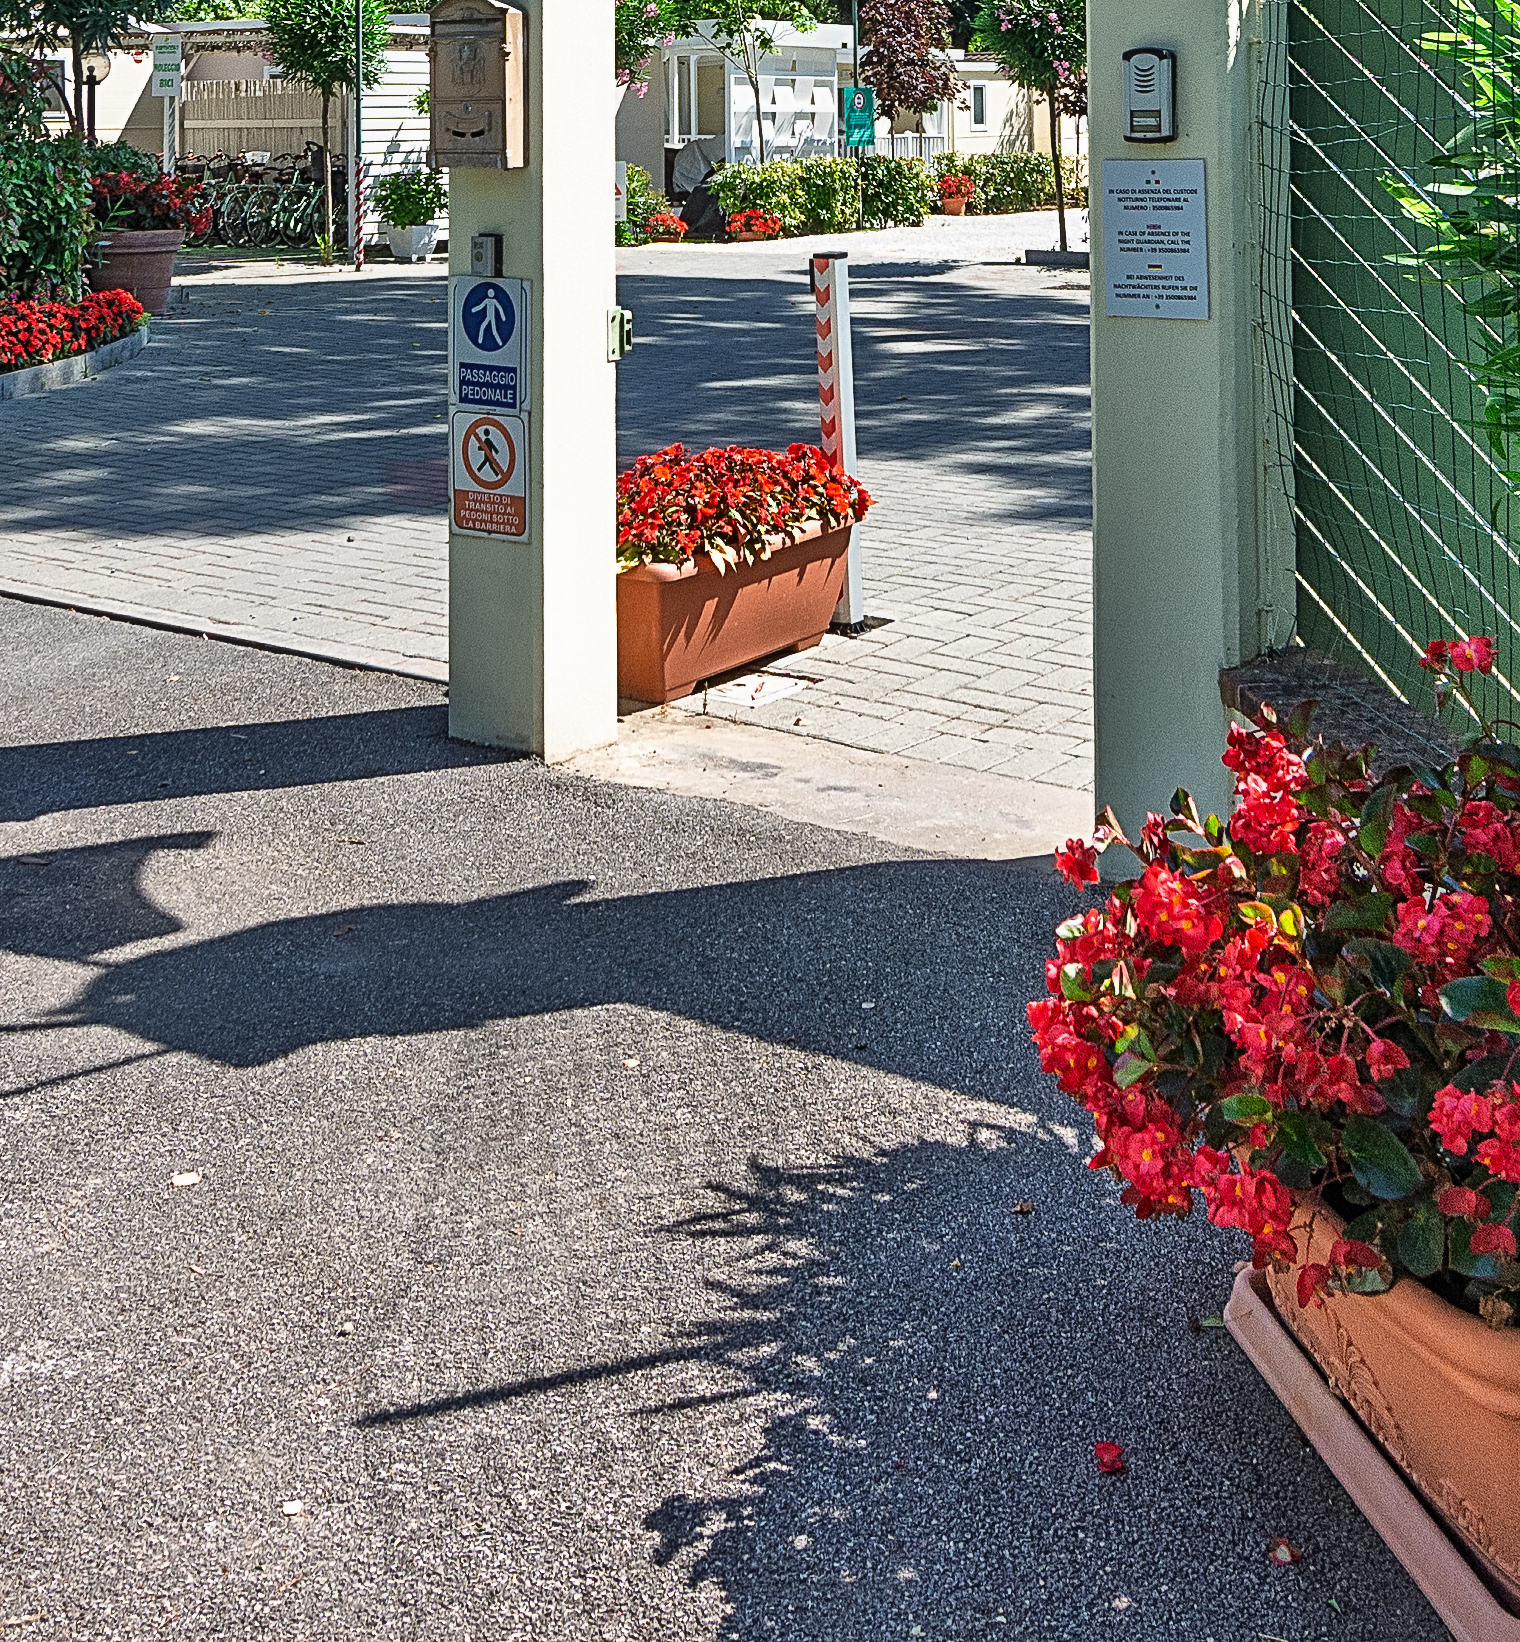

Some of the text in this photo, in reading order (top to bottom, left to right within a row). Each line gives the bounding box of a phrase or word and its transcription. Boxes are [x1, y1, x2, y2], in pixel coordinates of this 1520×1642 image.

[159, 79, 174, 88] BICI
[460, 368, 516, 386] PASSAGGIO
[462, 385, 514, 403] PEDONALE
[468, 492, 511, 504] DIVIETO DI
[464, 500, 515, 514] TRANSITO AI
[460, 509, 519, 524] PEDONI SOTTO
[463, 520, 517, 533] LA BARRIERA
